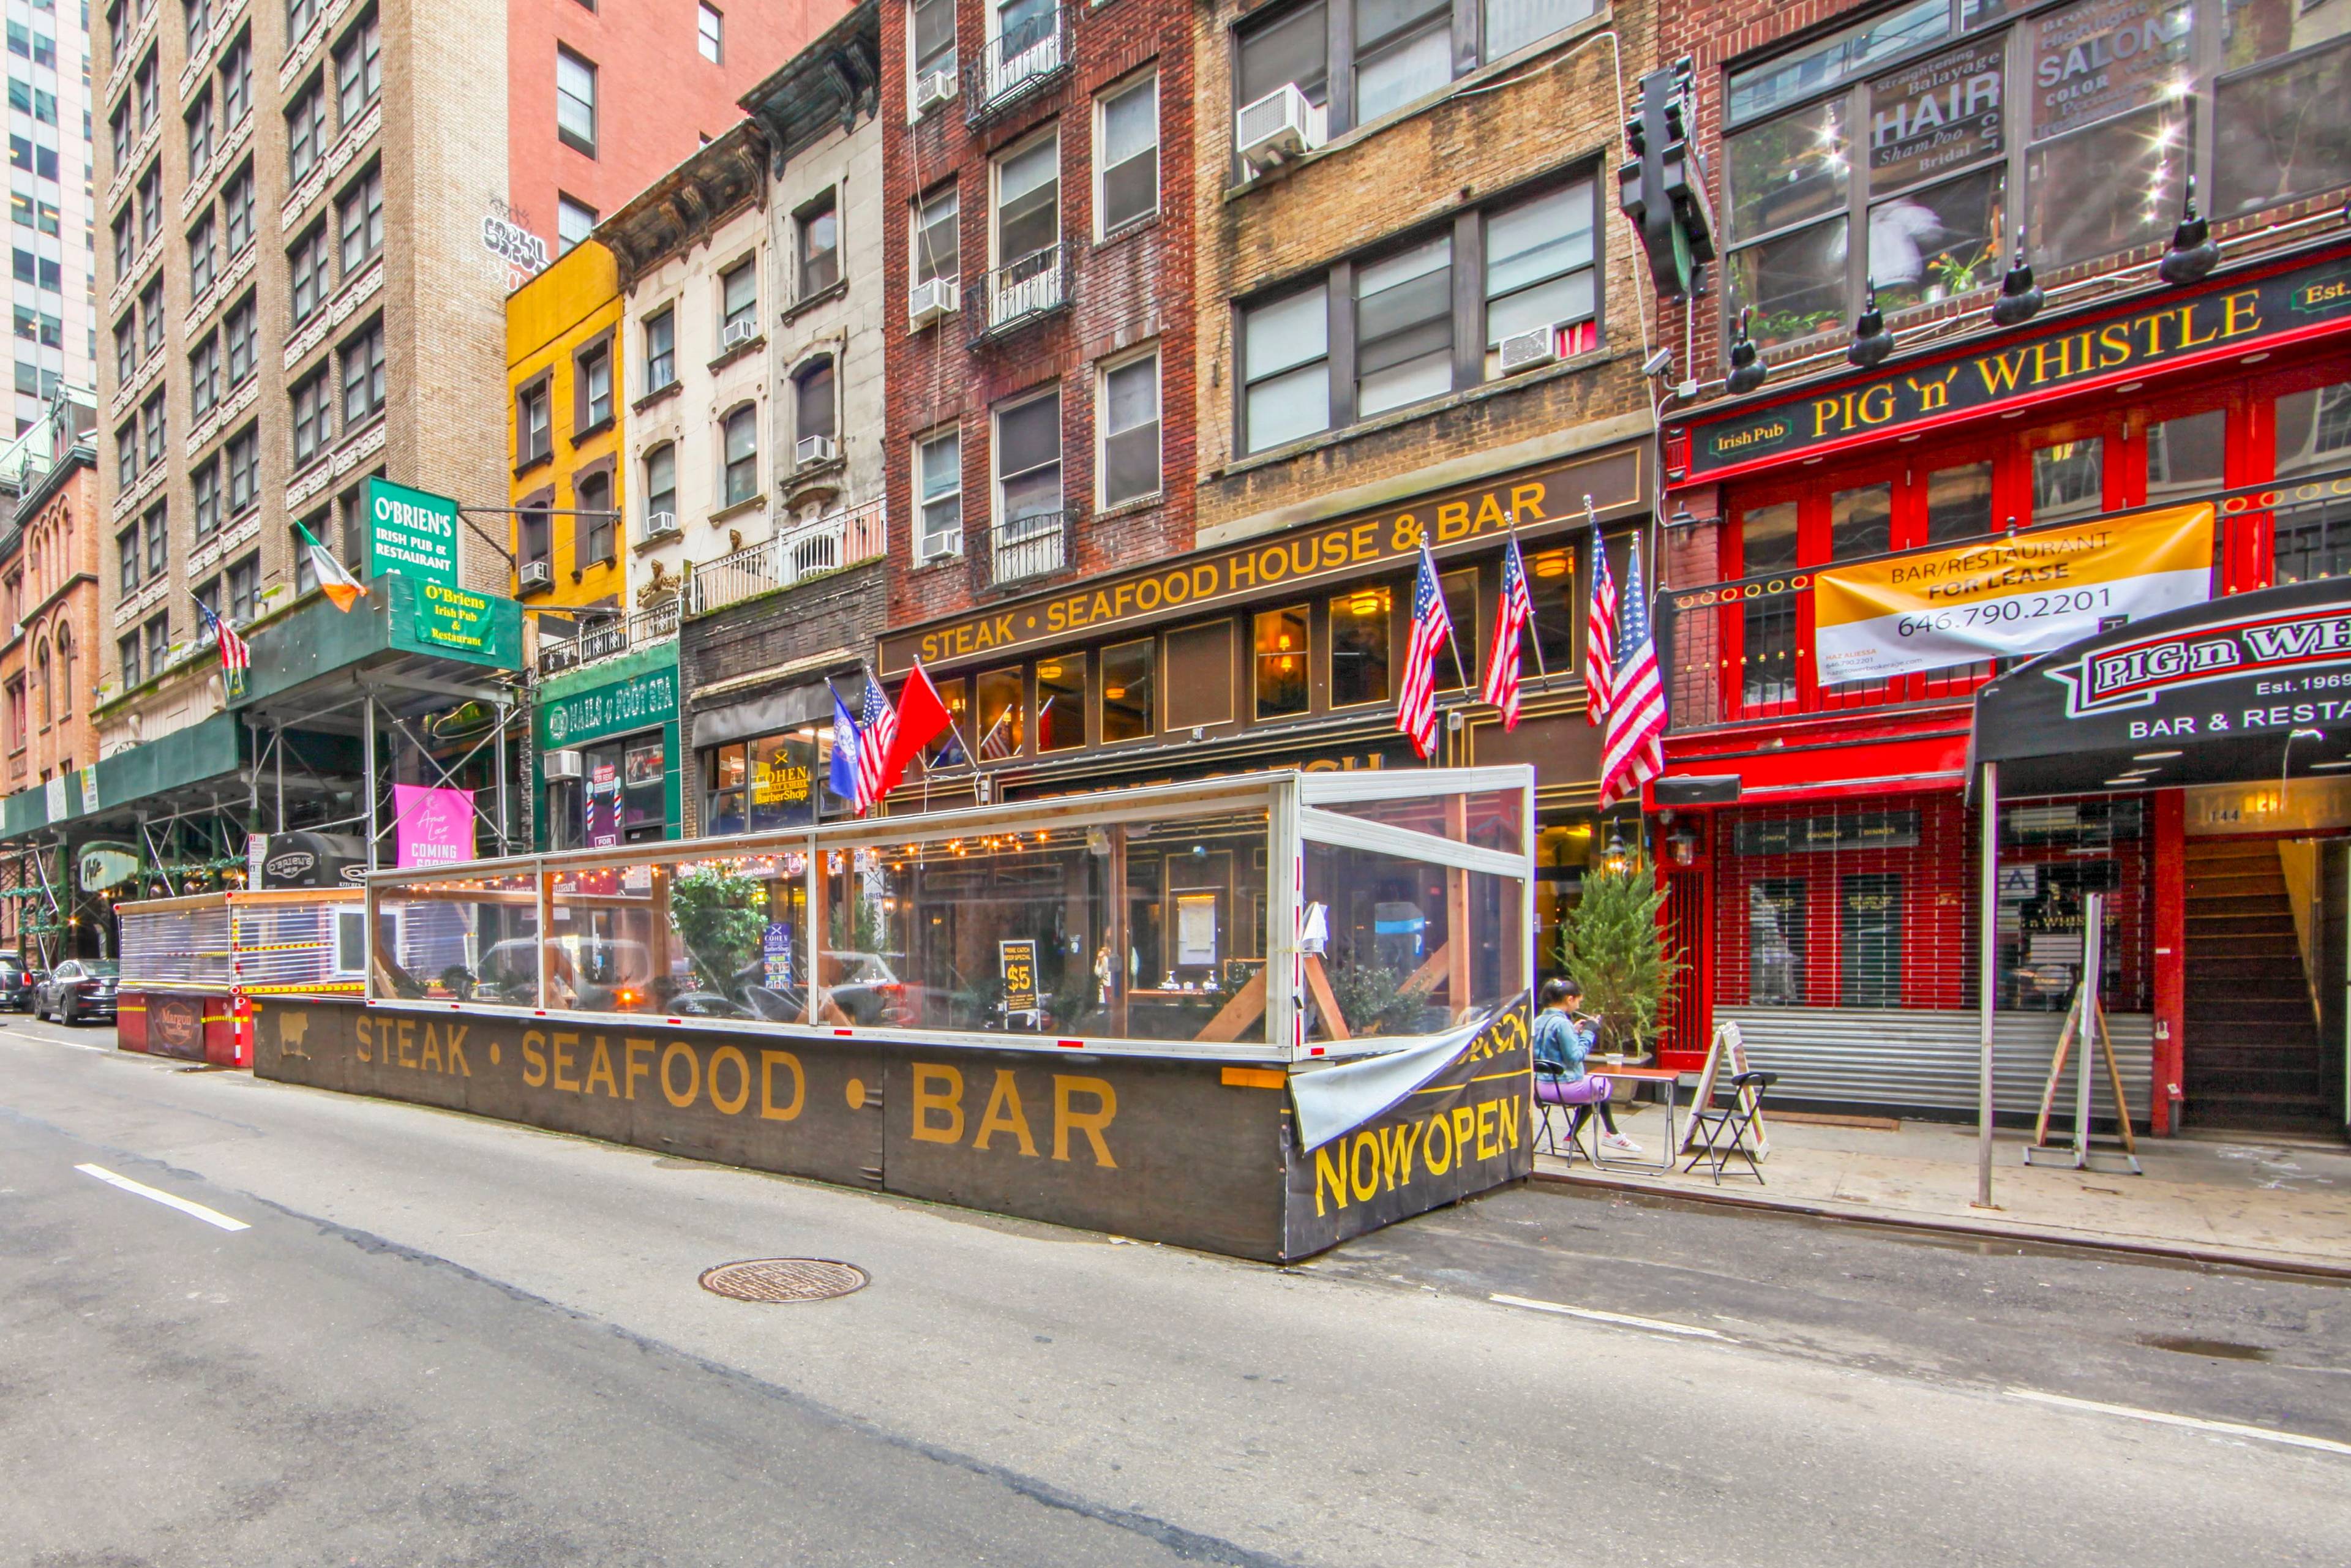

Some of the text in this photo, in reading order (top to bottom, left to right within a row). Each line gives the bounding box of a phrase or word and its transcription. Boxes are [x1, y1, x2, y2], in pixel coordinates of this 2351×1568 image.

[2037, 6, 2192, 88] SALON
[1877, 49, 1974, 92] Straightening
[1907, 51, 2000, 97] Balayage
[2045, 74, 2109, 107] COLOR
[1875, 71, 2000, 147] HAIR
[1979, 113, 1999, 150] CUT
[1919, 144, 1971, 171] Bridal
[2305, 280, 2351, 304] Est.
[1812, 383, 1897, 438] PIG
[1974, 288, 2263, 396] WHISTLE
[1718, 424, 1784, 451] Irish Pub
[375, 497, 452, 537] O'BRIEN'S
[377, 528, 446, 555] IRISH PUB &
[376, 543, 451, 571] RESTAURANT
[1892, 531, 2112, 584] BAR/RESTAURANT
[922, 482, 1546, 661] STEAK SEAFOOD HOUSE & BAR
[1929, 563, 2071, 599] FOR LEASE
[426, 585, 486, 609] O'Briens
[435, 605, 478, 622] Irish Pub
[451, 621, 461, 631] &
[1899, 588, 2110, 637] 646.790.2201
[432, 629, 482, 646] Restaurant
[1826, 657, 1873, 669] 646.790.2201
[1844, 648, 1877, 658] ALIESSA
[2100, 647, 2184, 688] PIG
[2197, 642, 2236, 667] n
[569, 696, 602, 732] NAILS
[615, 684, 646, 721] FOOT
[2129, 717, 2196, 738] BAR
[2208, 713, 2230, 730] &
[603, 773, 613, 782] RENT
[755, 766, 807, 784] COHEN
[756, 789, 808, 804] BarberShop
[2210, 809, 2239, 822] 144
[1864, 827, 1895, 836] DINNER
[411, 843, 457, 858] COMING
[2006, 870, 2028, 889] A
[1008, 964, 1030, 992] $5
[162, 1010, 192, 1029] Margon
[356, 1015, 1118, 1168] STEAK SEAFOOD BAR
[1314, 1095, 1520, 1217] NOW OPEN
